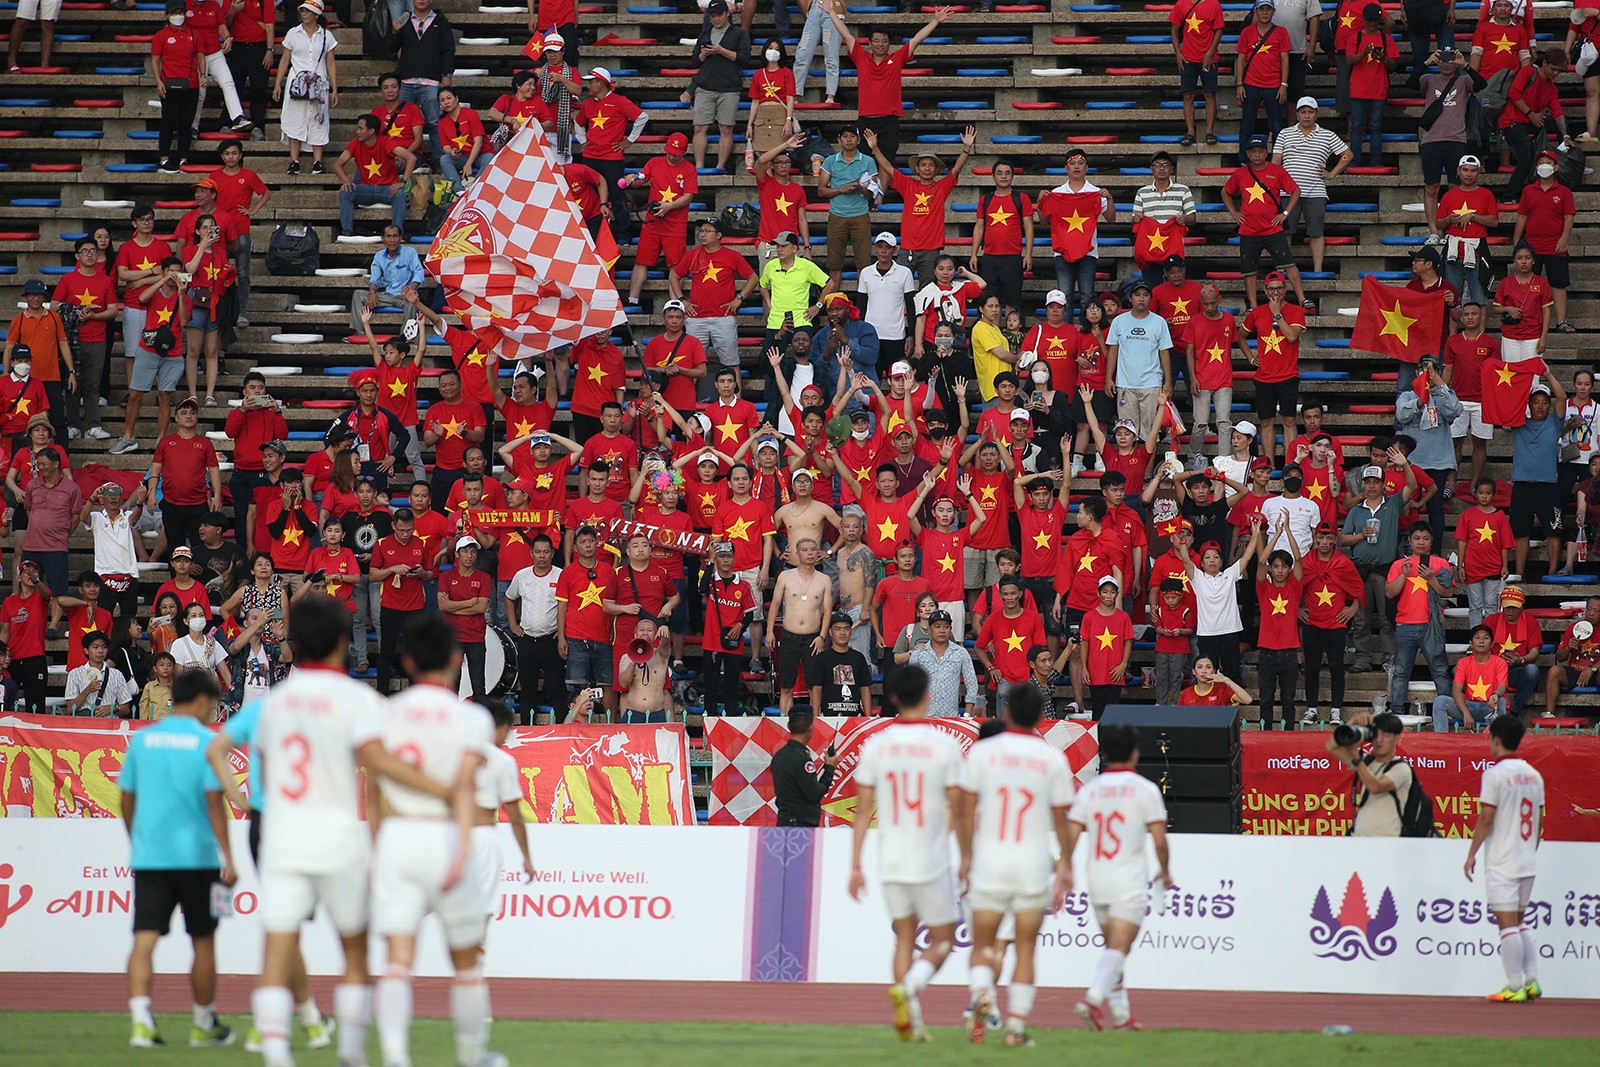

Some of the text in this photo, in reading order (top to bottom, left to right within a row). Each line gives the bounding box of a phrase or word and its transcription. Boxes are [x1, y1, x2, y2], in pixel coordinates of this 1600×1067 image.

[477, 510, 541, 525] VIỆT NAM
[610, 518, 711, 551] VIET NA
[281, 731, 312, 806] 3
[1267, 754, 1330, 769] metfone
[1417, 756, 1446, 769] Nam
[885, 770, 925, 829] 14
[1304, 788, 1346, 816] ĐỘI
[997, 785, 1036, 843] 17
[1519, 796, 1534, 842] 8
[83, 866, 108, 878] Eat
[571, 870, 605, 883] Live
[610, 870, 649, 884] Well.
[496, 893, 672, 921] JINOMOTO
[1139, 930, 1236, 954] Airways
